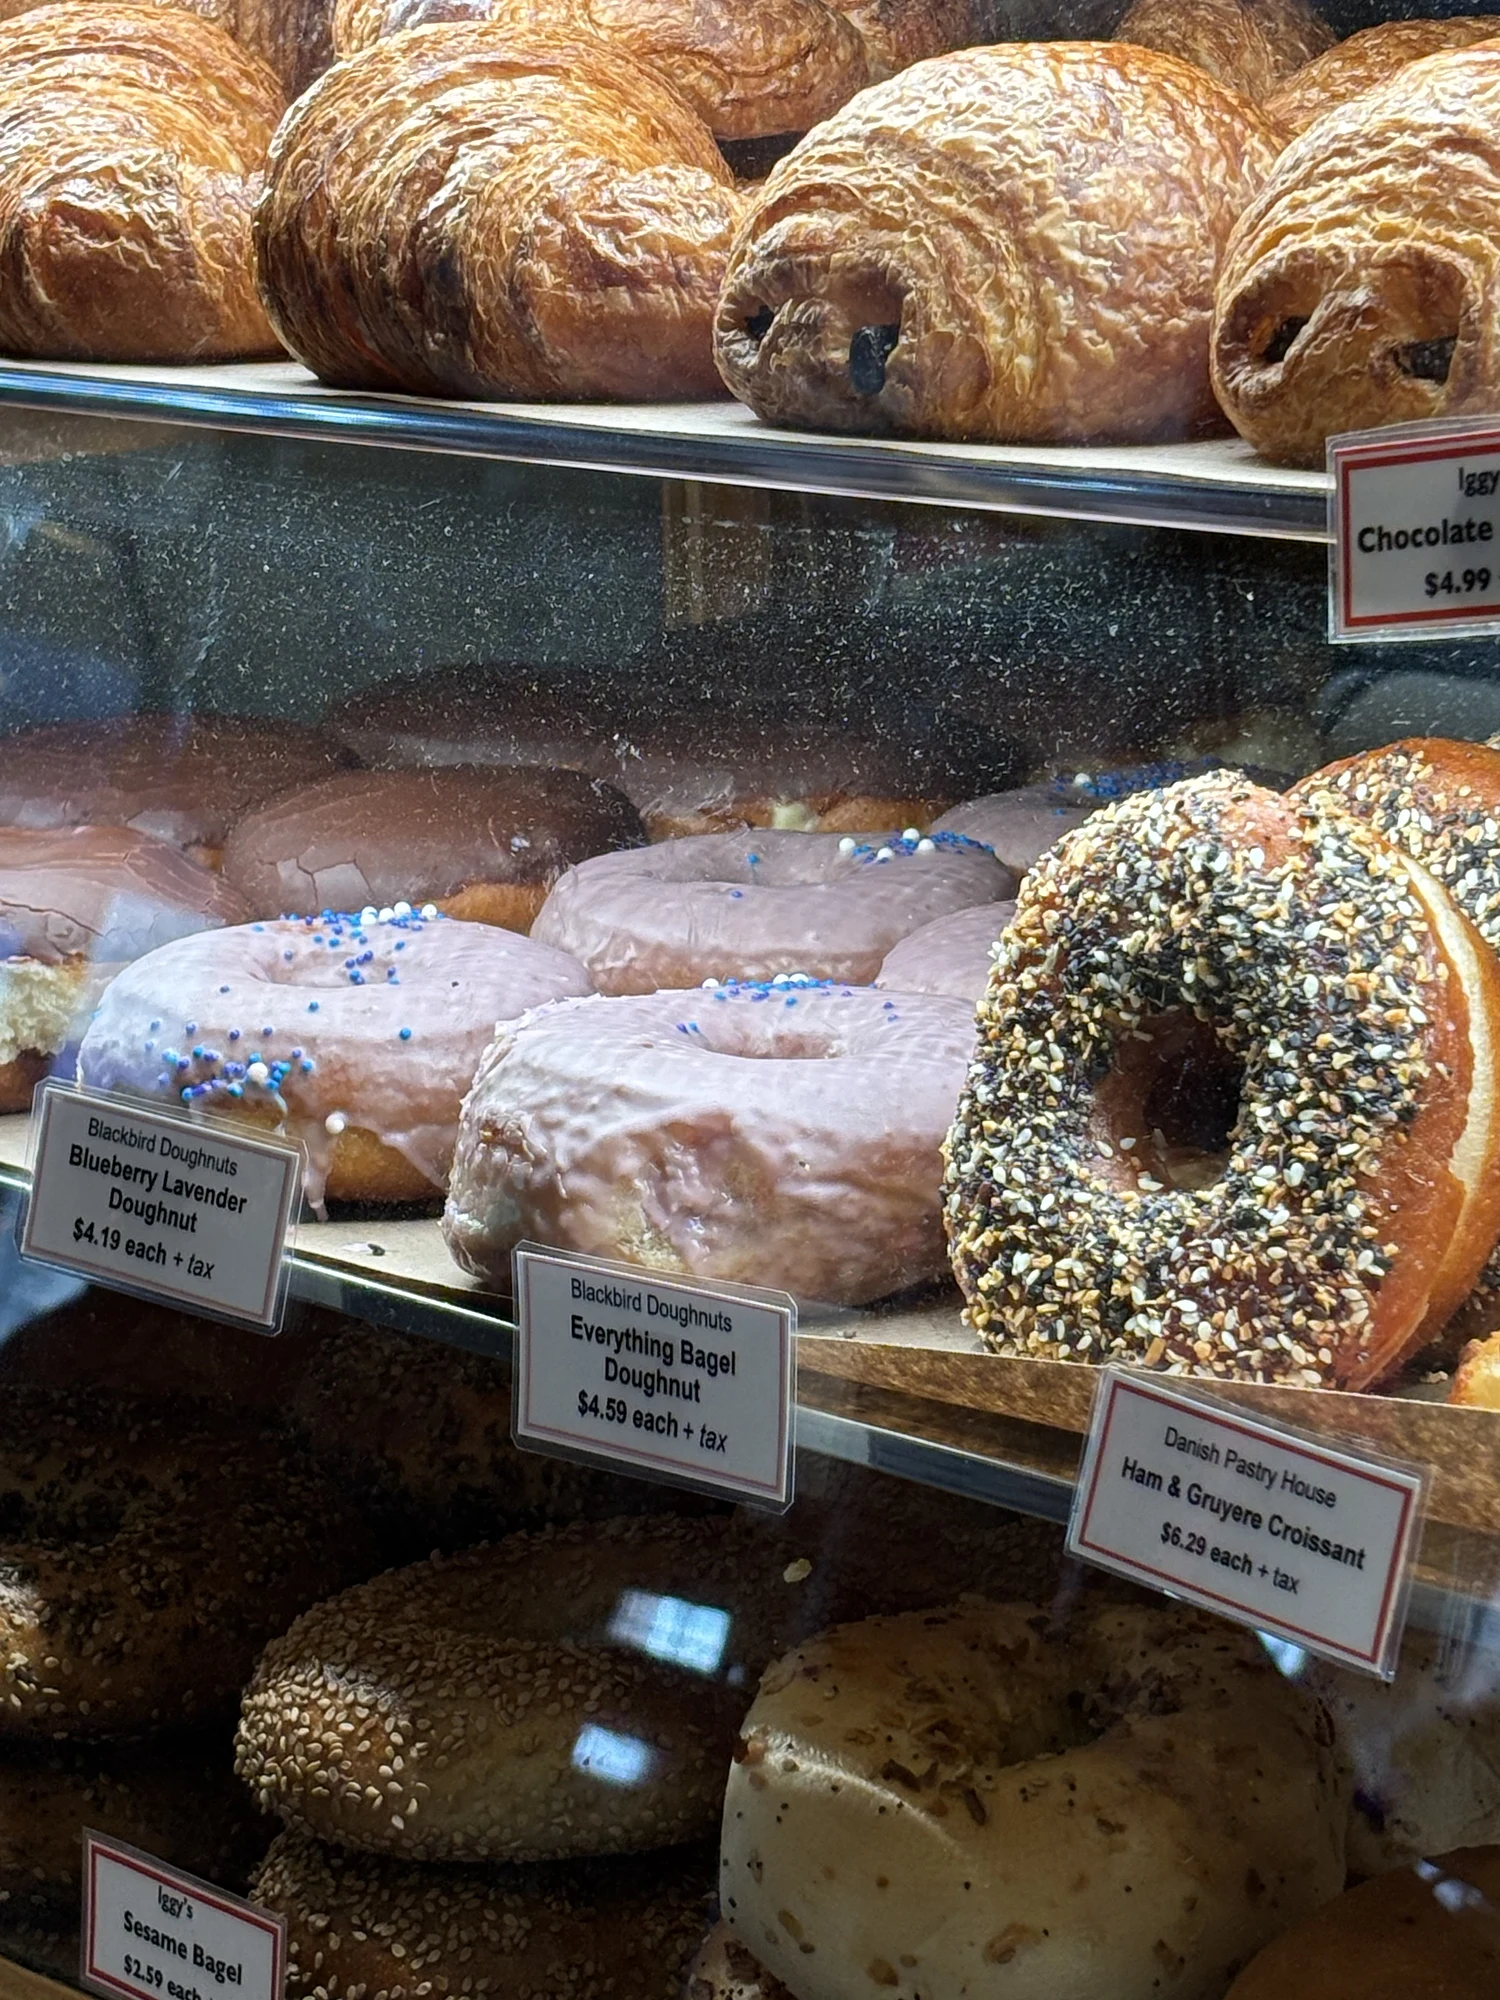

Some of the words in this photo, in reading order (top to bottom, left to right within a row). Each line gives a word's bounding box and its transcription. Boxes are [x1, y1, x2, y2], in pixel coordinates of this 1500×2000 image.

[1358, 518, 1493, 553] Chocolate
[1424, 567, 1492, 598] $4.99
[88, 1117, 157, 1153] Blackbird
[160, 1137, 238, 1176] Doughnuts
[69, 1144, 158, 1192] Blueberry
[162, 1171, 247, 1214] Lavender
[109, 1188, 198, 1233] Doughnut
[72, 1217, 121, 1250] $4.19
[124, 1237, 166, 1265] each
[173, 1252, 183, 1267] +
[187, 1253, 215, 1280] tax
[571, 1278, 642, 1313] Blackbird
[647, 1294, 733, 1333] Doughnuts
[571, 1315, 674, 1366] Everything
[680, 1340, 736, 1377] Bagel
[605, 1357, 701, 1403] Doughnut
[578, 1389, 627, 1424] $4.59
[632, 1407, 678, 1438] each
[683, 1422, 694, 1439] +
[700, 1424, 728, 1453] tax
[1164, 1426, 1220, 1465] Danish
[1224, 1449, 1278, 1490] Pastry
[1279, 1470, 1338, 1509] House
[1121, 1457, 1163, 1493] Ham
[1167, 1476, 1181, 1498] &
[1187, 1482, 1262, 1530] Gruyere
[1268, 1514, 1367, 1571] Croissant
[1160, 1522, 1207, 1557] $6.29
[1209, 1544, 1252, 1576] each
[1258, 1565, 1269, 1578] +
[1273, 1567, 1300, 1595] tax
[158, 1885, 194, 1919] Iggy's
[124, 1911, 188, 1960] Sesame
[193, 1944, 243, 1986] Bagel
[124, 1954, 163, 1988] $2.59
